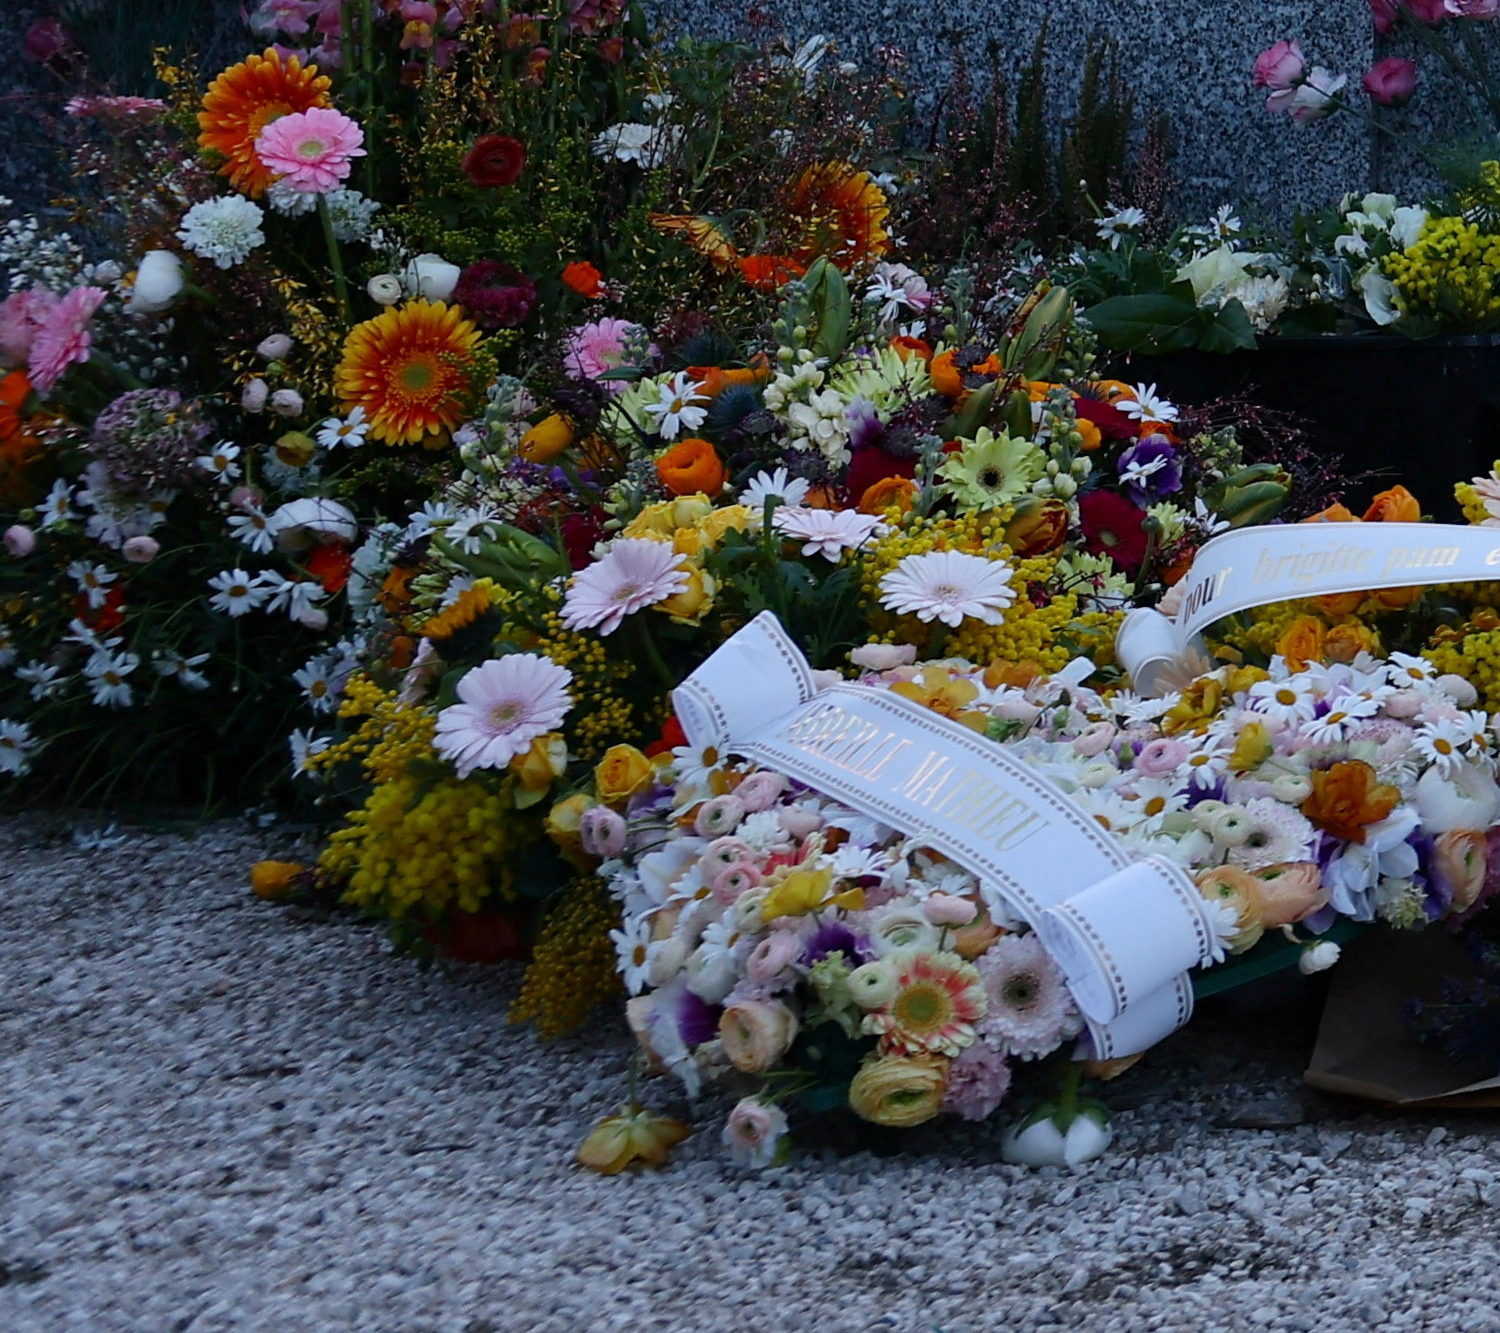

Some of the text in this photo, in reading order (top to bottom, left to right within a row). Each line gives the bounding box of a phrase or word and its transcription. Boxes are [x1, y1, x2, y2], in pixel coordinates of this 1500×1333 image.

[1182, 564, 1233, 627] pour
[1253, 539, 1374, 586] brigitte
[1381, 543, 1461, 580] pam
[892, 750, 1050, 852] MATHIEU
